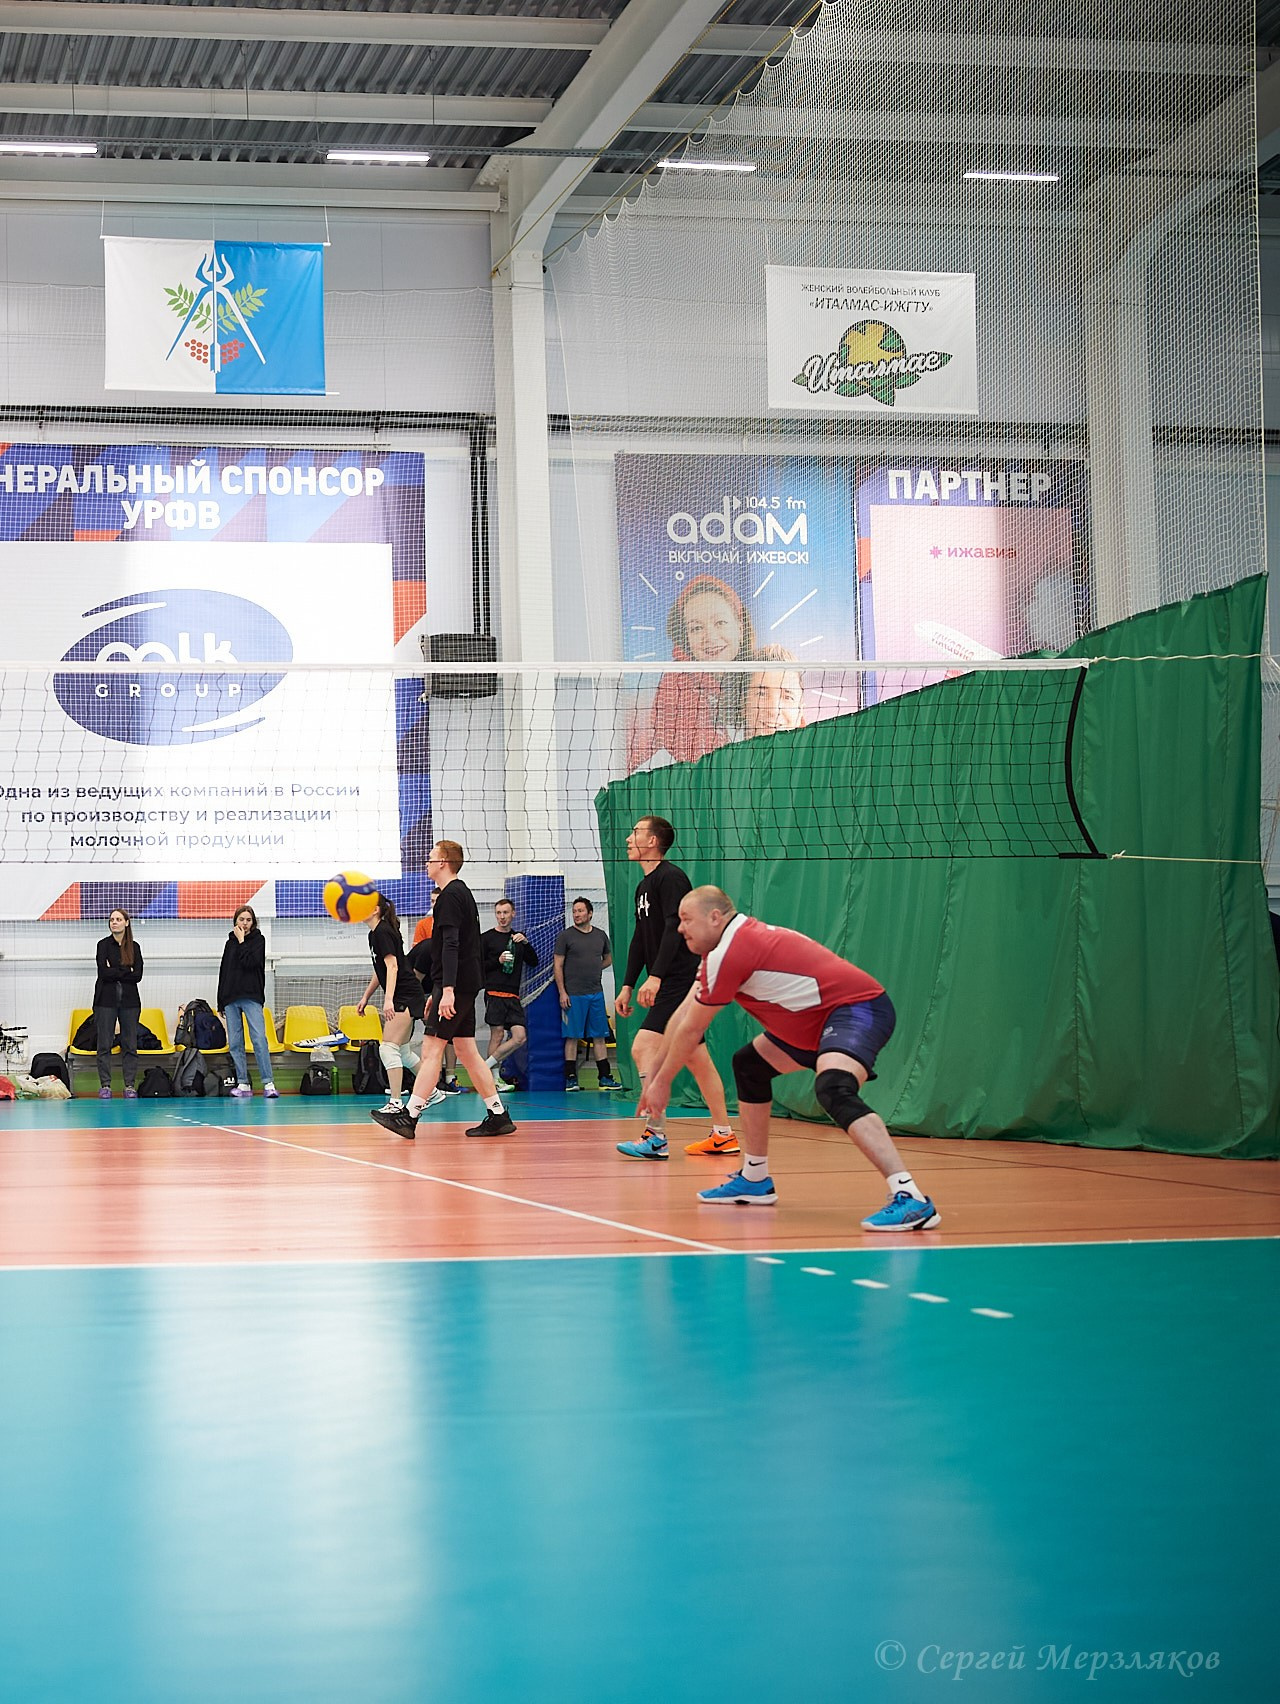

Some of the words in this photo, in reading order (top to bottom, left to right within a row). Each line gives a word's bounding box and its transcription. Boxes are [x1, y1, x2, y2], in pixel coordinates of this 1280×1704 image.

[801, 284, 844, 294] ЖЕНСКИЙ
[847, 285, 917, 296] ВОЛЕЙБОЛЬНЫЙ
[919, 288, 940, 297] КЛУБ
[221, 466, 385, 497] СПОНСОР
[888, 470, 1051, 501] ПАРТНЕР
[746, 497, 780, 509] 104.5
[786, 496, 806, 509] fm
[121, 500, 220, 530] УРФВ
[669, 547, 743, 564] ВКЛЮЧАЙ,
[747, 551, 809, 564] ИЖЕВСК!
[95, 683, 242, 698] GROUP
[48, 786, 70, 798] из
[76, 785, 164, 801] ведущих
[170, 782, 268, 798] компаний
[275, 786, 284, 797] в
[291, 784, 360, 797] России
[21, 810, 45, 823] по
[51, 809, 189, 826] производству
[196, 810, 207, 821] и
[214, 809, 332, 825] реализации
[70, 831, 170, 847] молочной
[176, 833, 284, 849] продукции
